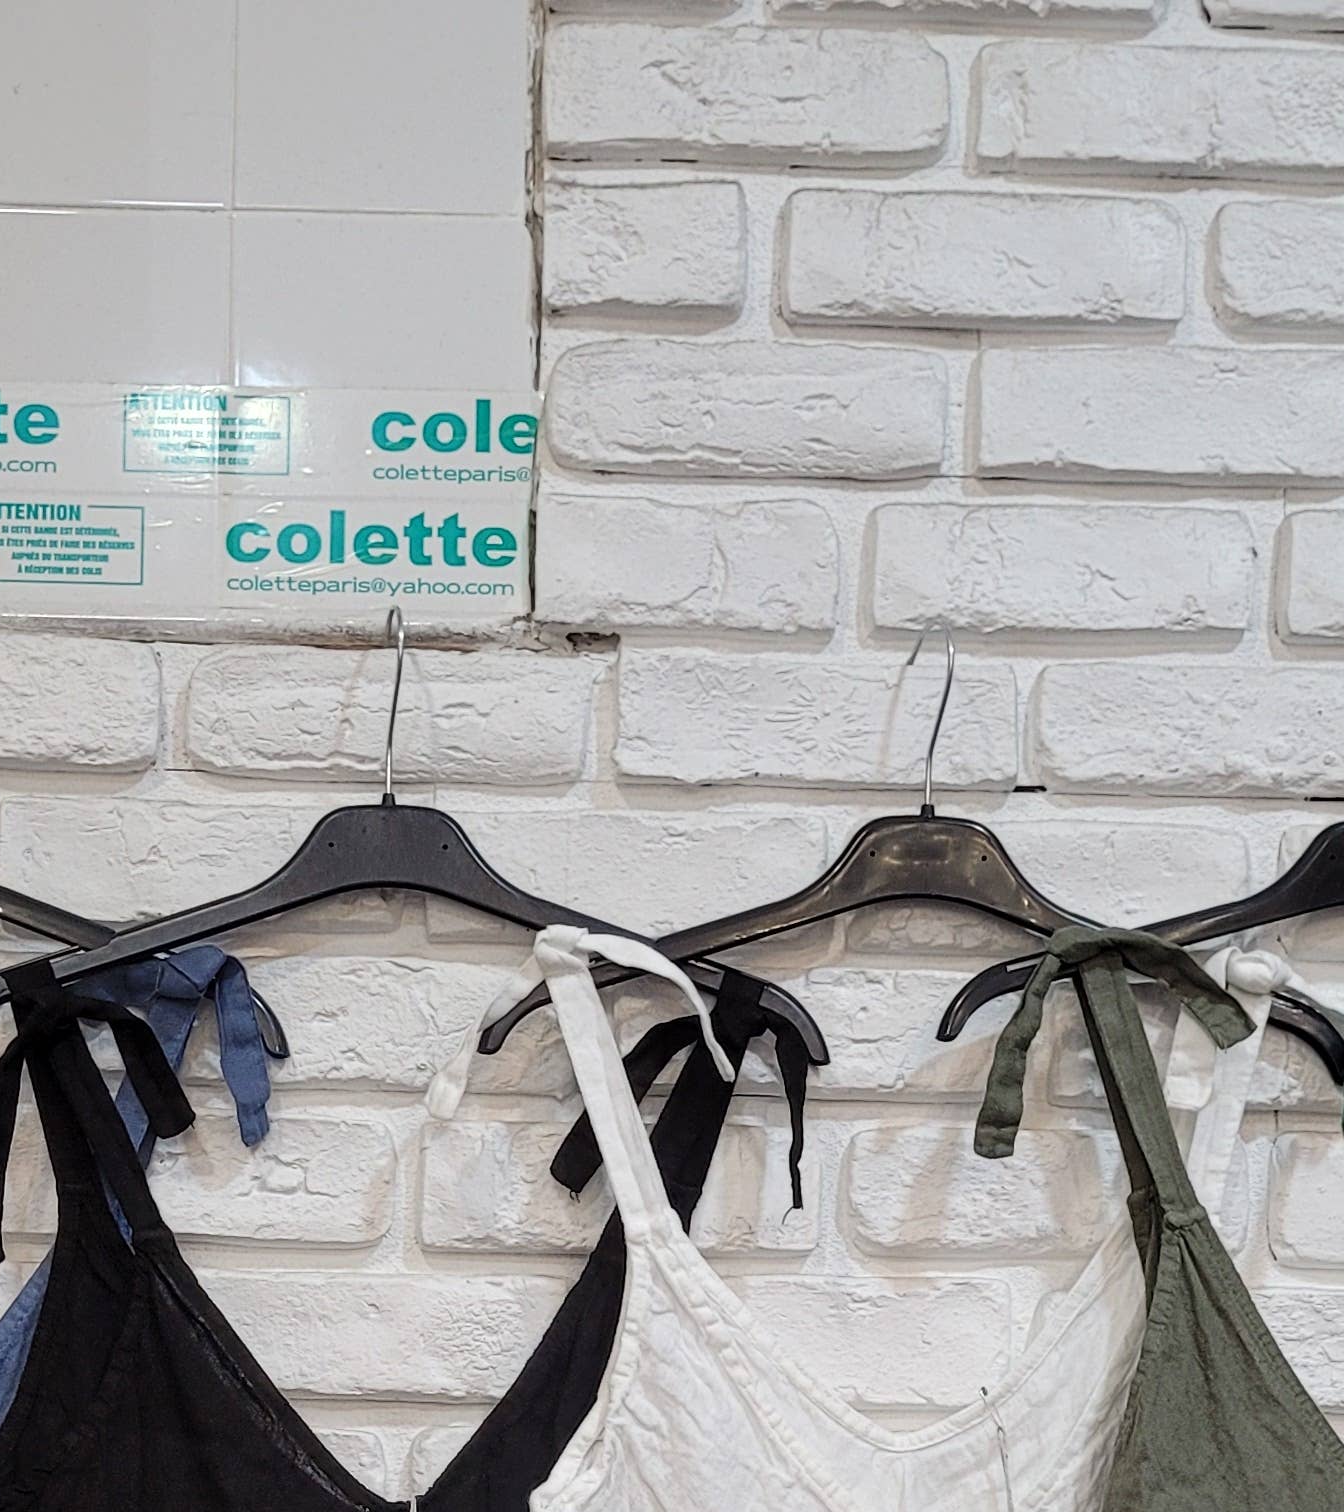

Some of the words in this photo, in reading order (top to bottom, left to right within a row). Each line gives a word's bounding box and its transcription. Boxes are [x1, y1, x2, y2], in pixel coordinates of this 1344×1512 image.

[128, 393, 228, 412] ATTENTION
[225, 509, 518, 567] colette
[227, 575, 514, 597] coletteparis@yahoo.com
